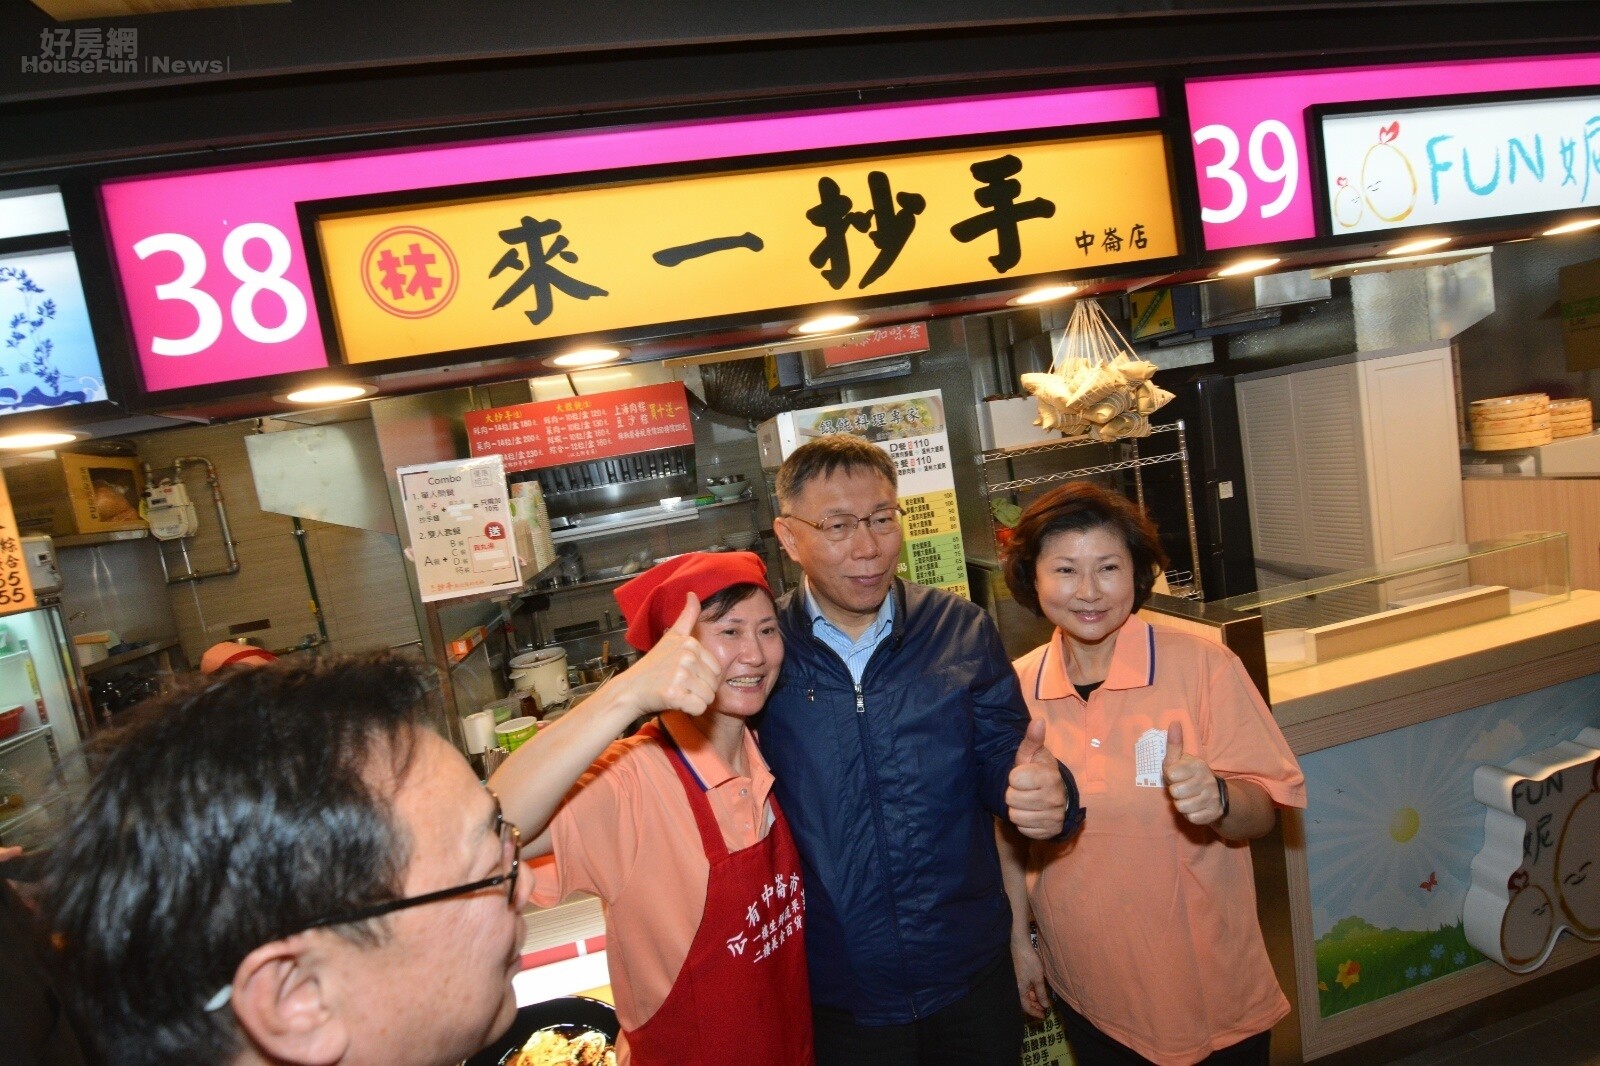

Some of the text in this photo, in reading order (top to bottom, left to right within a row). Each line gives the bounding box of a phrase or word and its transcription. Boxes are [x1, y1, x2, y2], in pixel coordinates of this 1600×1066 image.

[1192, 119, 1299, 224] 39
[1426, 133, 1545, 205] FUN
[489, 154, 1056, 326] 來一抄手
[1075, 223, 1148, 256] 中崙店
[132, 222, 308, 357] 38
[377, 243, 443, 301] 林
[820, 407, 922, 434] 餛飩料理專家
[914, 438, 930, 448] 110
[916, 455, 932, 465] 110
[427, 475, 462, 485] Combo
[488, 525, 502, 537] 送
[1511, 773, 1563, 813] FUN
[745, 872, 806, 928] 有中崙市
